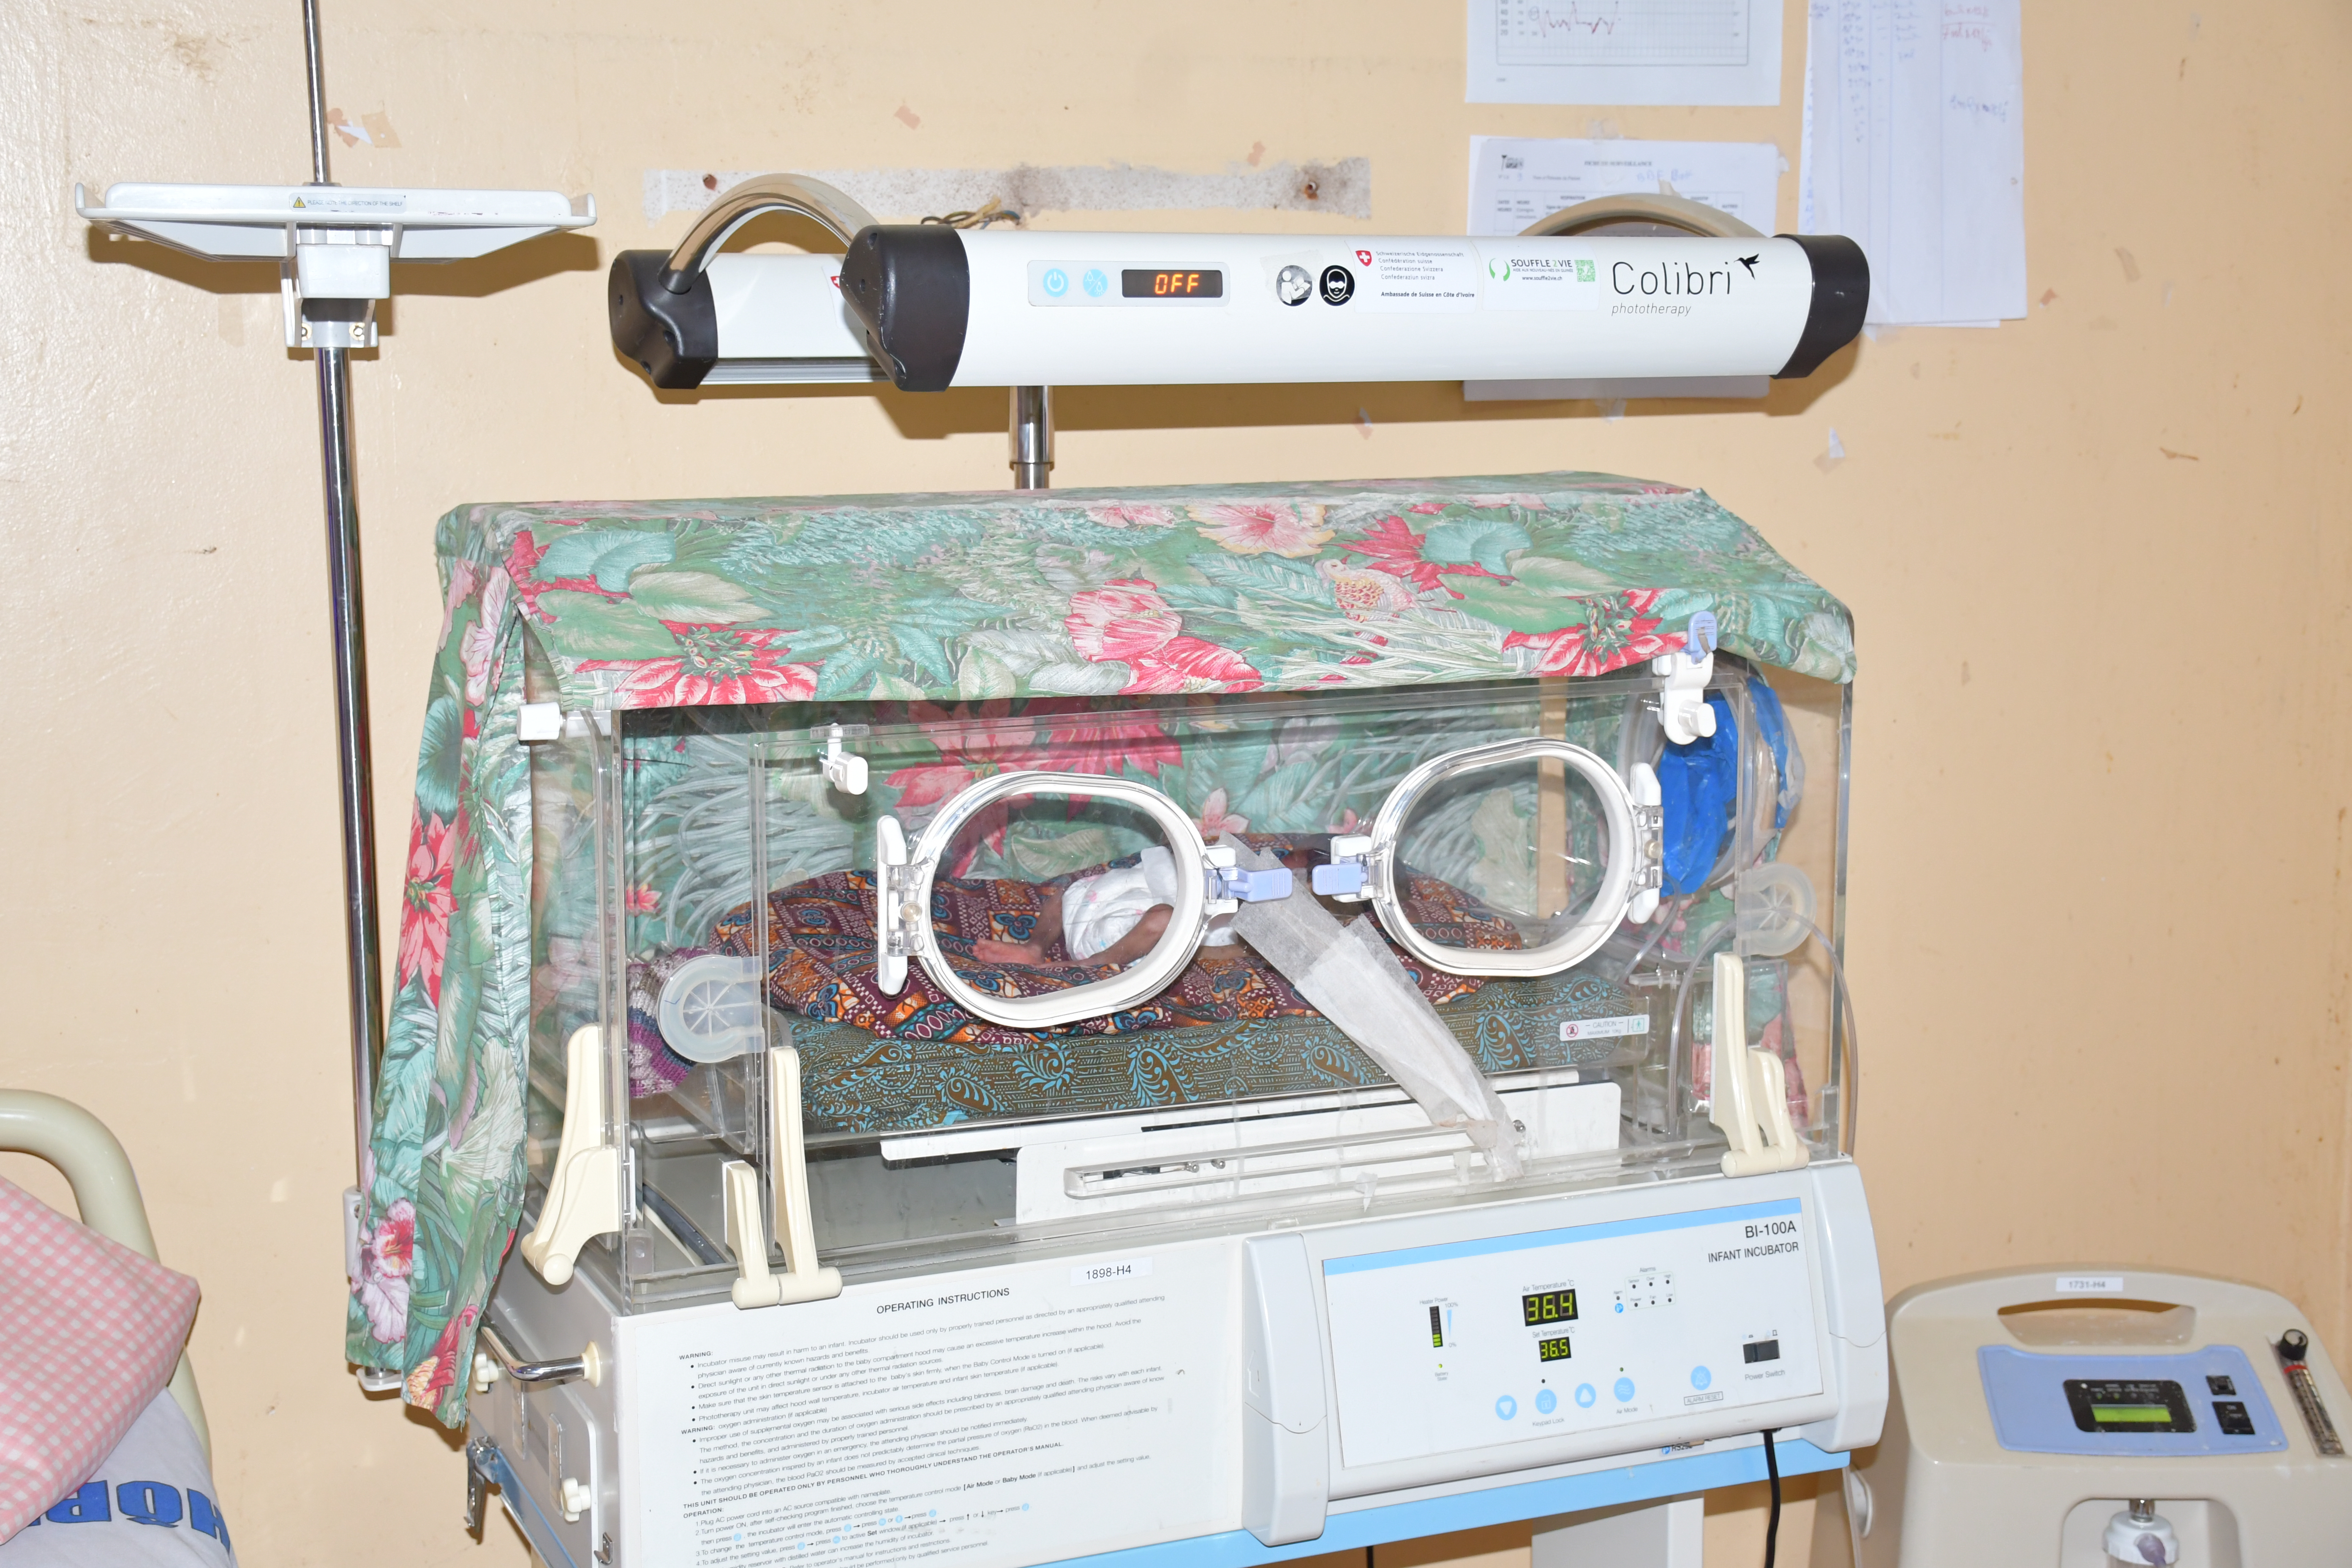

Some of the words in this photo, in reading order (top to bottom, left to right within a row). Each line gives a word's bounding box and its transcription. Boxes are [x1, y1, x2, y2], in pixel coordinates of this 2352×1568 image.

[1155, 274, 1199, 294] OFF
[1612, 261, 1730, 294] Colibri
[1611, 302, 1691, 317] phototherapy
[1745, 1220, 1796, 1238] BI-100A
[1708, 1249, 1741, 1263] INFANT
[1744, 1241, 1799, 1258] INCUBATOR
[1086, 1265, 1131, 1279] 1898-H4
[1532, 1282, 1566, 1290] Temperature
[877, 1298, 933, 1314] OPERATING
[938, 1288, 1009, 1305] INSTRUCTIONS
[1527, 1292, 1573, 1322] 36.4
[697, 1359, 727, 1368] Incubator
[948, 1323, 972, 1332] properly
[996, 1315, 1024, 1325] personnel
[1034, 1310, 1057, 1318] directed
[1076, 1303, 1112, 1312] appropriately
[1114, 1298, 1137, 1307] qualified
[1541, 1328, 1568, 1336] Temperature
[679, 1351, 713, 1360] WARNING:
[1541, 1339, 1568, 1359] 36.5
[698, 1370, 726, 1379] physician
[757, 1361, 782, 1369] currently
[806, 1354, 830, 1362] hazards
[1765, 1369, 1785, 1377] Switch
[681, 1425, 715, 1434] WARNING:
[743, 1414, 786, 1425] administration
[795, 1407, 827, 1417] applicable)
[719, 1494, 747, 1503] SHOULD
[759, 1485, 795, 1496] OPERATED
[827, 1473, 868, 1484] PERSONNEL
[886, 1462, 931, 1474] THOROUGHLY
[933, 1455, 977, 1467] UNDERSTAND
[993, 1446, 1033, 1457] OPERATOR'S
[1035, 1442, 1064, 1450] MANUAL.
[683, 1507, 724, 1518] OPERATION:
[727, 1514, 745, 1522] power
[814, 1496, 846, 1506] compatible
[861, 1489, 891, 1498] nameplate.
[25, 1479, 231, 1554] HÔP
